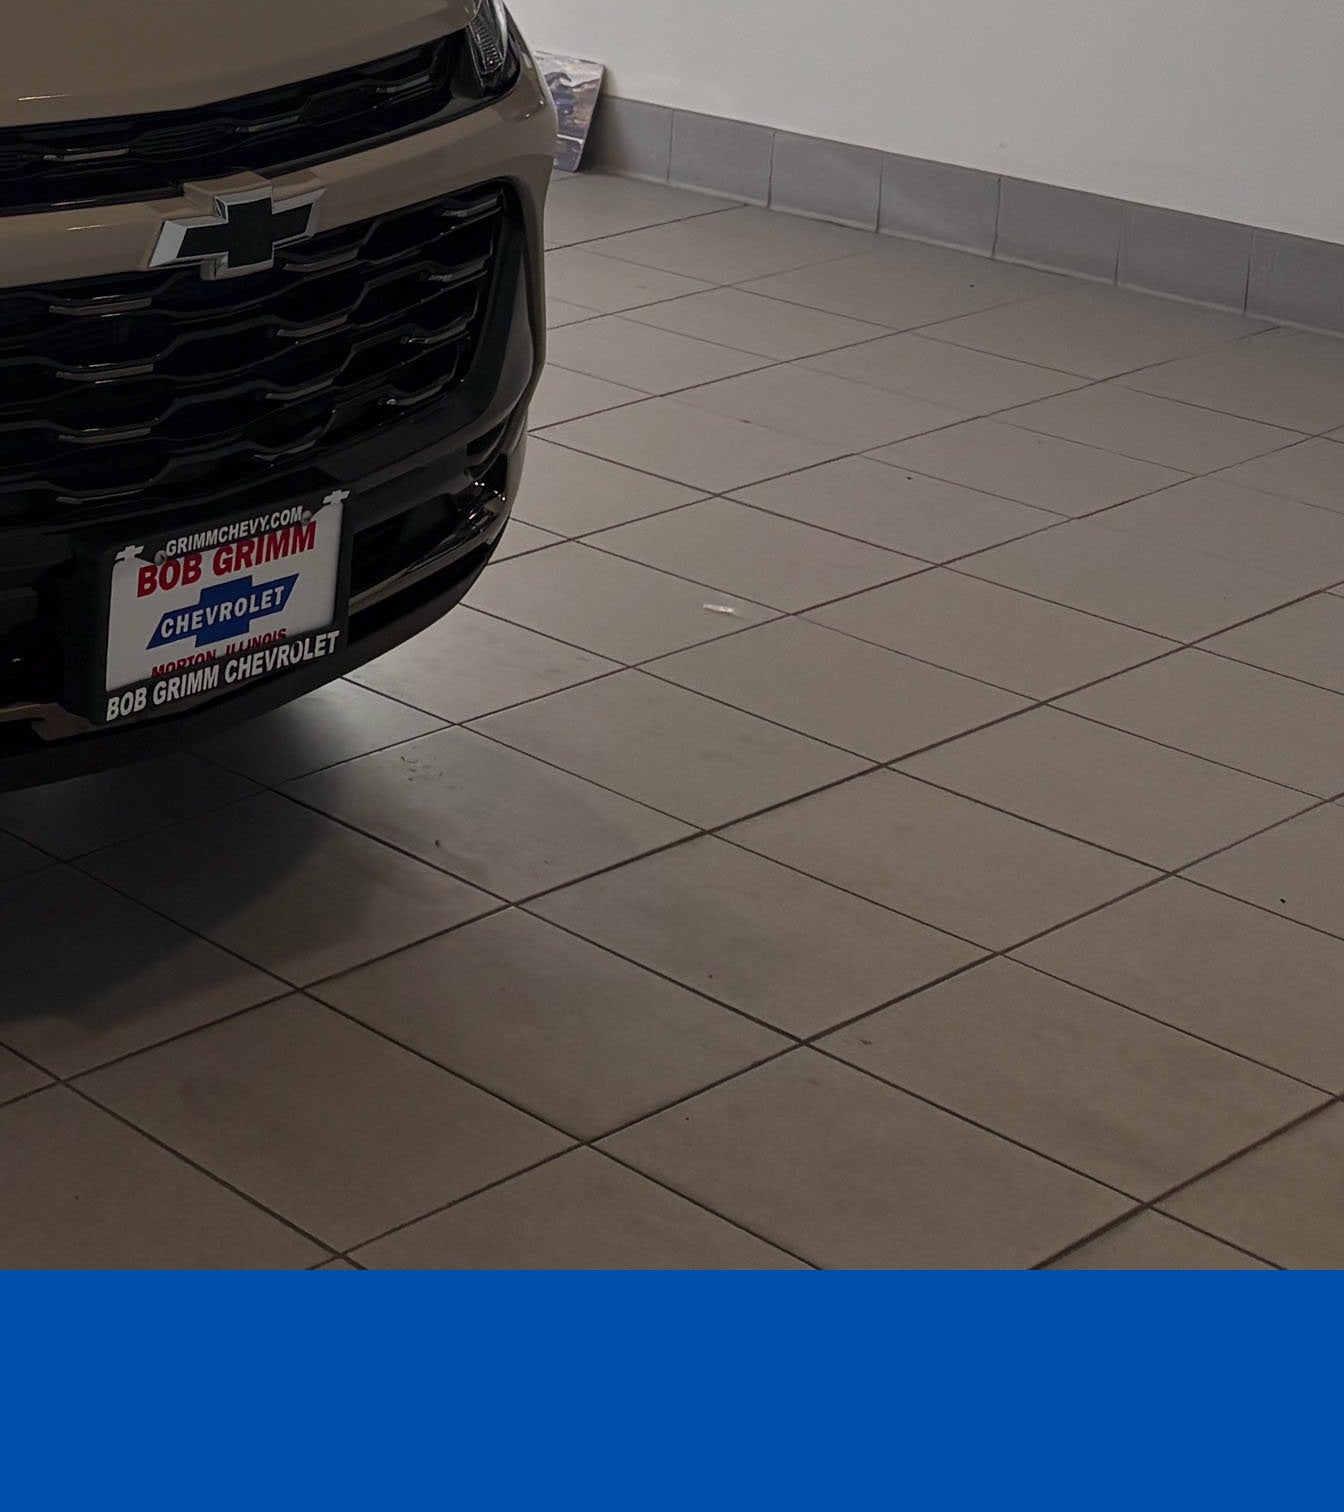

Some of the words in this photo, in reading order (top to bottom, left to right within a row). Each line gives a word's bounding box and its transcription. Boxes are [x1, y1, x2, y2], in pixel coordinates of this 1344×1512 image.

[138, 554, 203, 598] BOB
[212, 521, 317, 576] GRIMM
[166, 506, 303, 557] GRIMMCHEVY.COM
[160, 585, 285, 639] CHEVROLET
[106, 687, 148, 722] BOB
[152, 664, 219, 705] GRIMM
[224, 630, 341, 683] CHEVROLET
